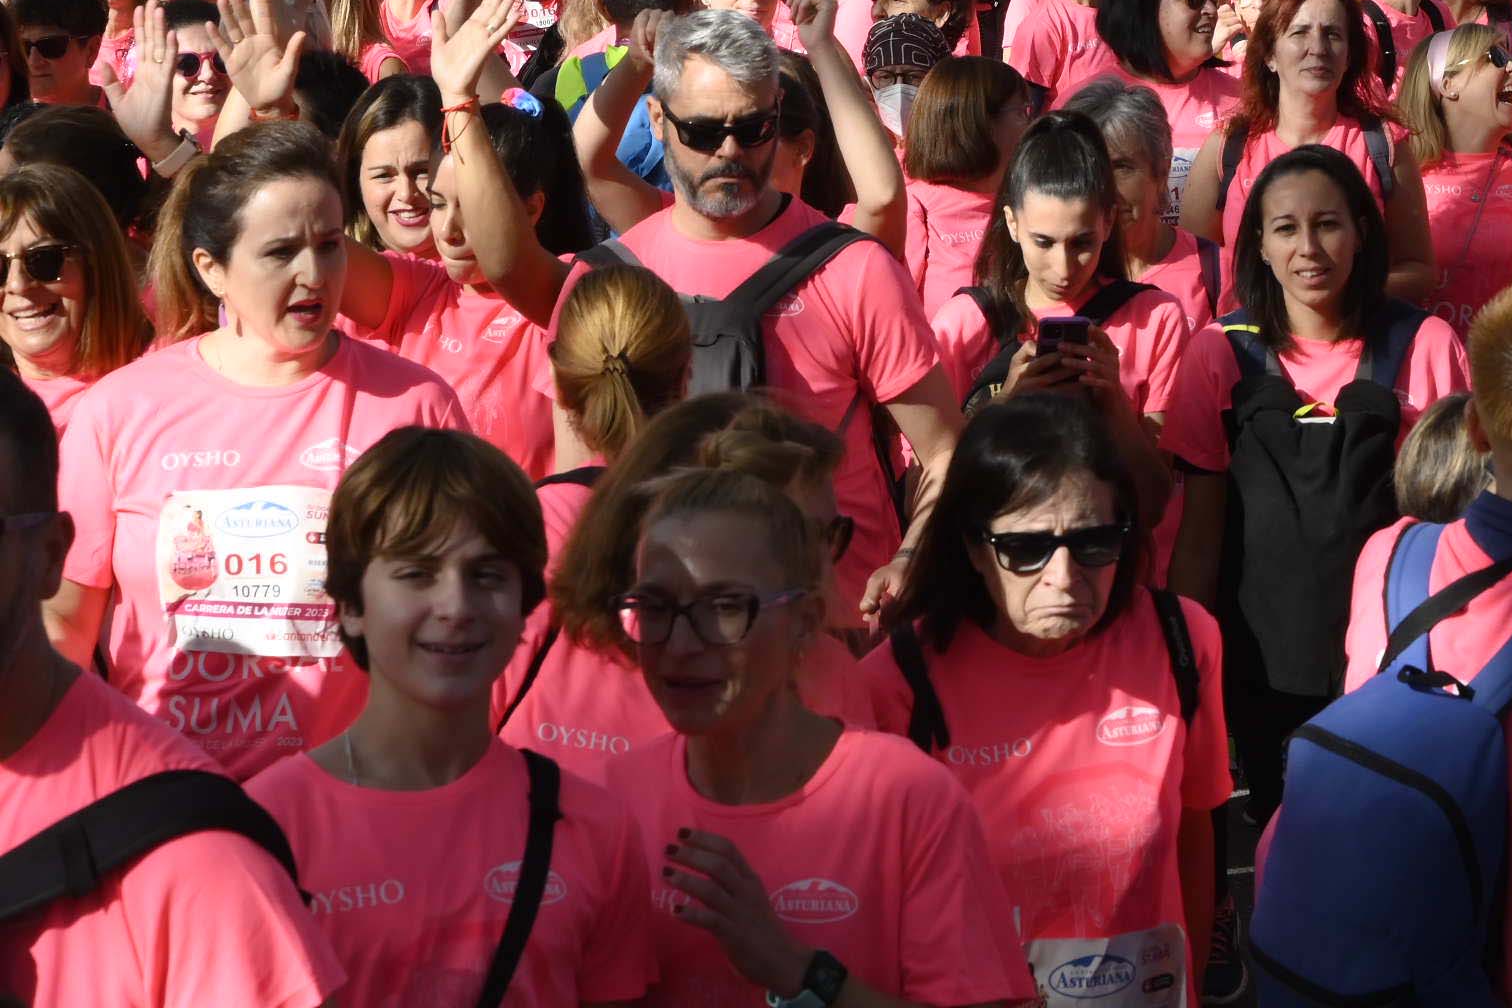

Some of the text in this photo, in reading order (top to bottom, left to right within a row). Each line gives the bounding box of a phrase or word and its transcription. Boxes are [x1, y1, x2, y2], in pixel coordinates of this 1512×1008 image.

[161, 449, 241, 472] OYSHO
[223, 514, 293, 530] ASTURIANA
[224, 552, 289, 577] 016
[231, 583, 282, 599] 10779
[184, 602, 234, 616] CARRERA
[236, 604, 252, 617] DE
[168, 692, 299, 735] SUMA
[536, 721, 631, 755] OYSHO
[948, 736, 1033, 767] OYSHO
[773, 894, 852, 914] ASTURIANA
[1056, 970, 1131, 989] ASTURIANA
